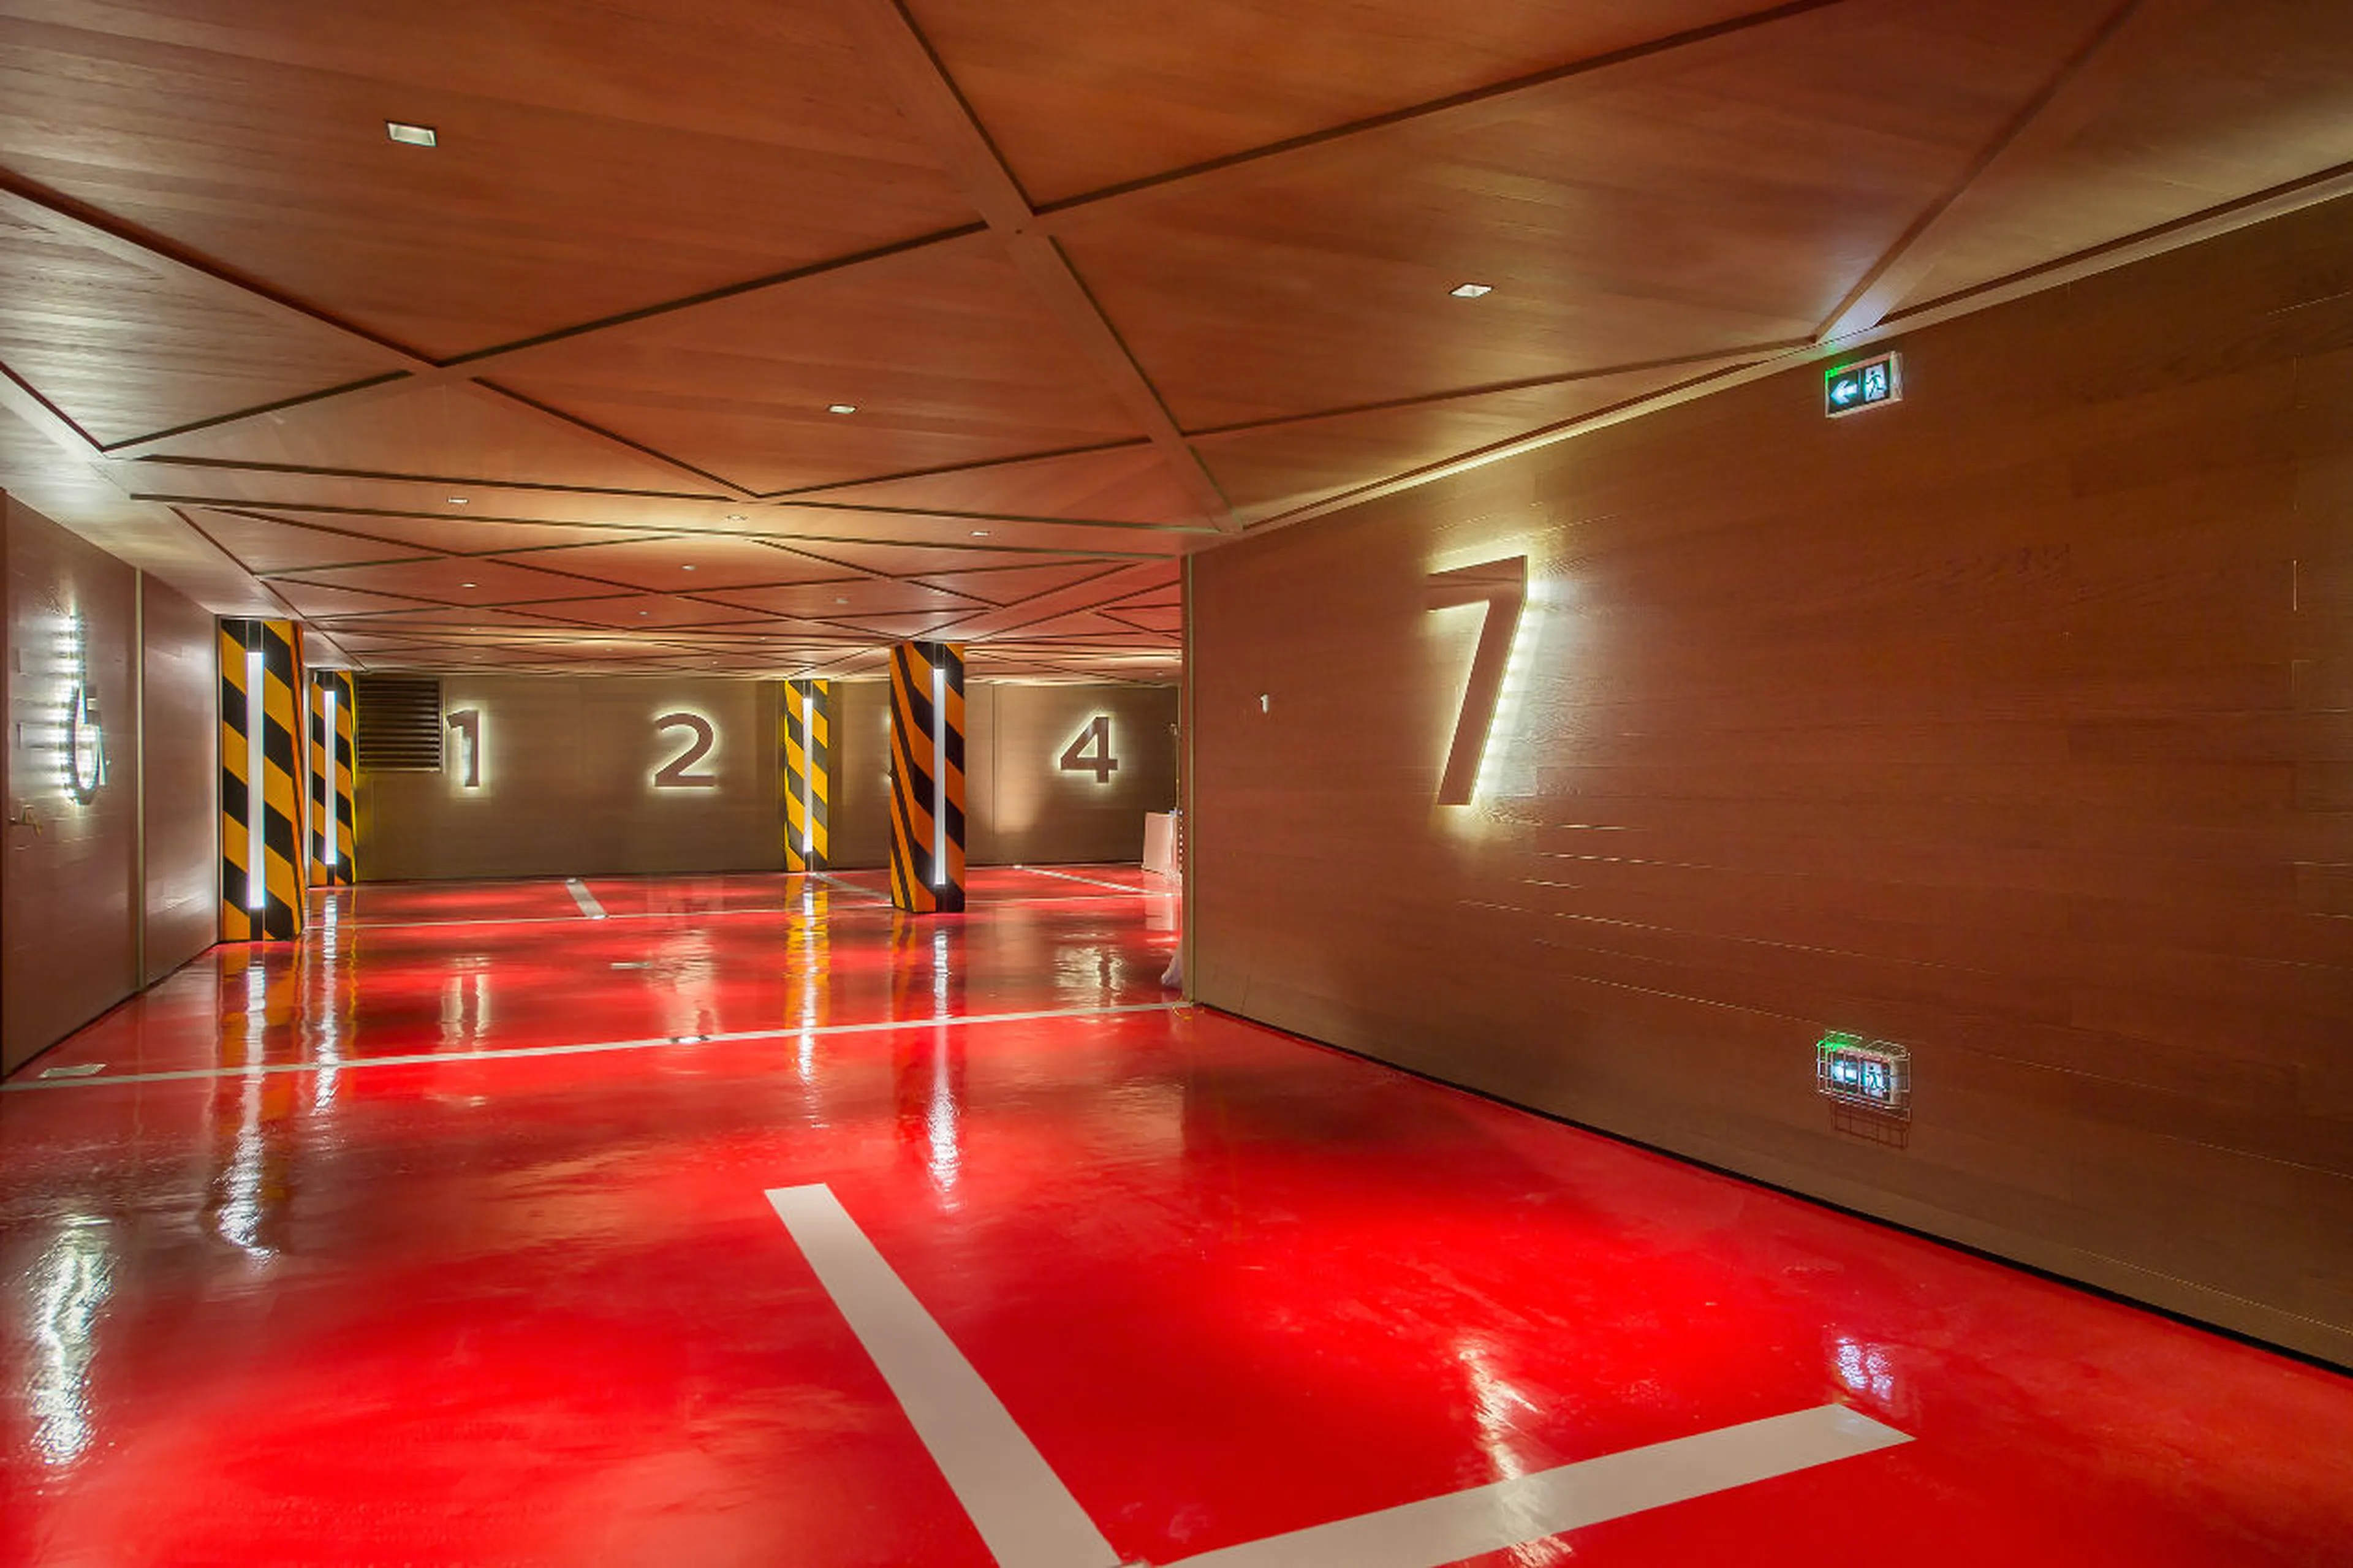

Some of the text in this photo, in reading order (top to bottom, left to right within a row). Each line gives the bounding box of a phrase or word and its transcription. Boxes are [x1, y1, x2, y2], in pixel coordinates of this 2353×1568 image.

[1425, 554, 1528, 806] 7
[446, 709, 480, 788] 1
[653, 713, 716, 787] 2
[1060, 716, 1118, 784] 4
